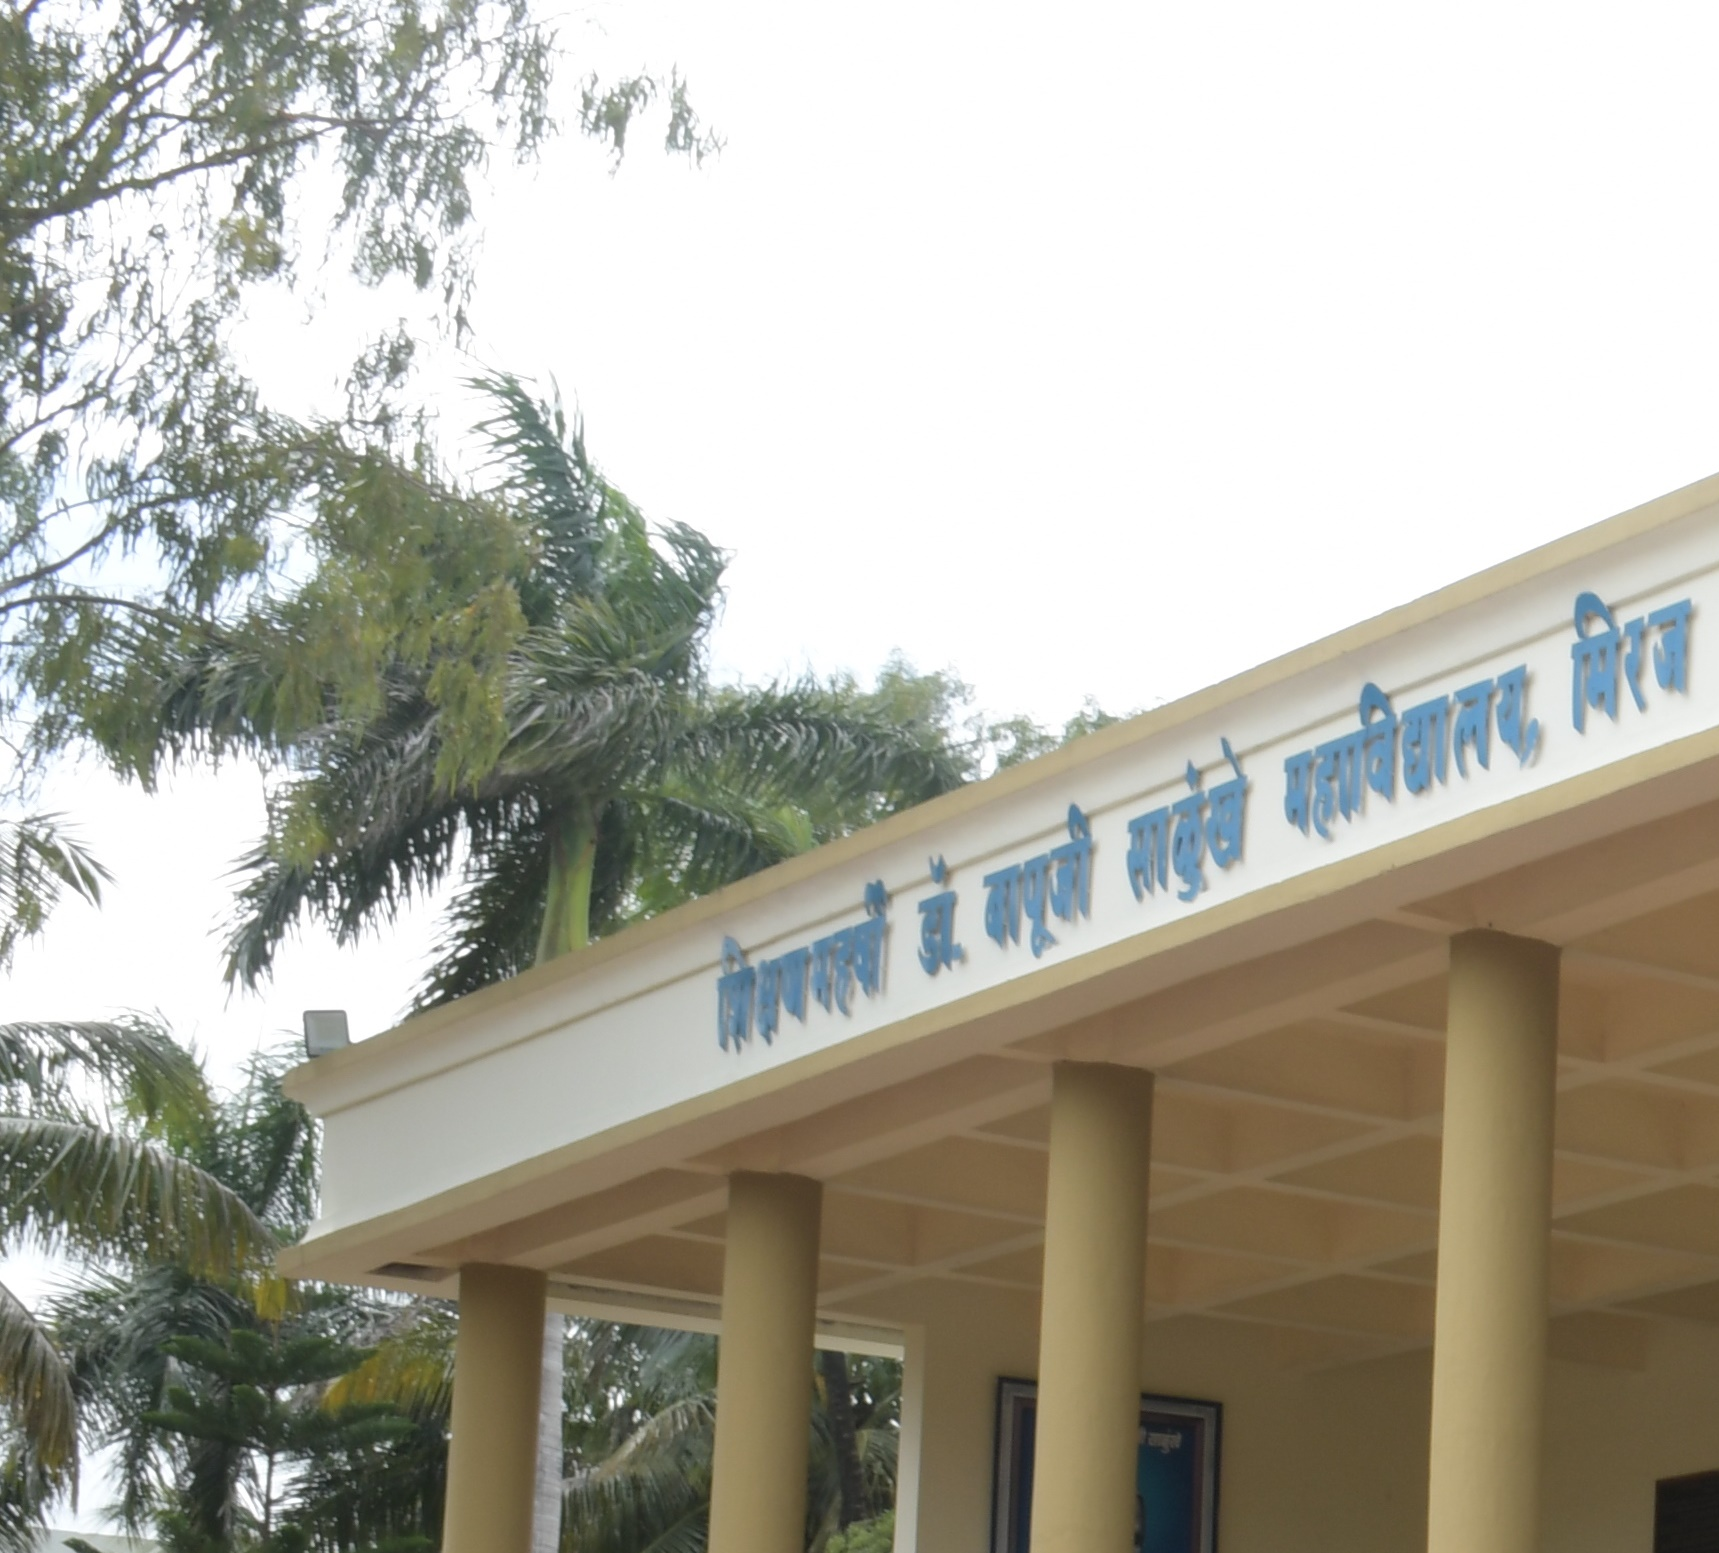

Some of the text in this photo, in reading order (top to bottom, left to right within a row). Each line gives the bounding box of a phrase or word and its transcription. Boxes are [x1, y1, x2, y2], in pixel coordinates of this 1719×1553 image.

[983, 803, 1093, 958] बापूजी
[1126, 735, 1248, 901] साळुंखे
[1284, 682, 1540, 840] महाविद्यालय,
[1571, 591, 1692, 734] मिरज
